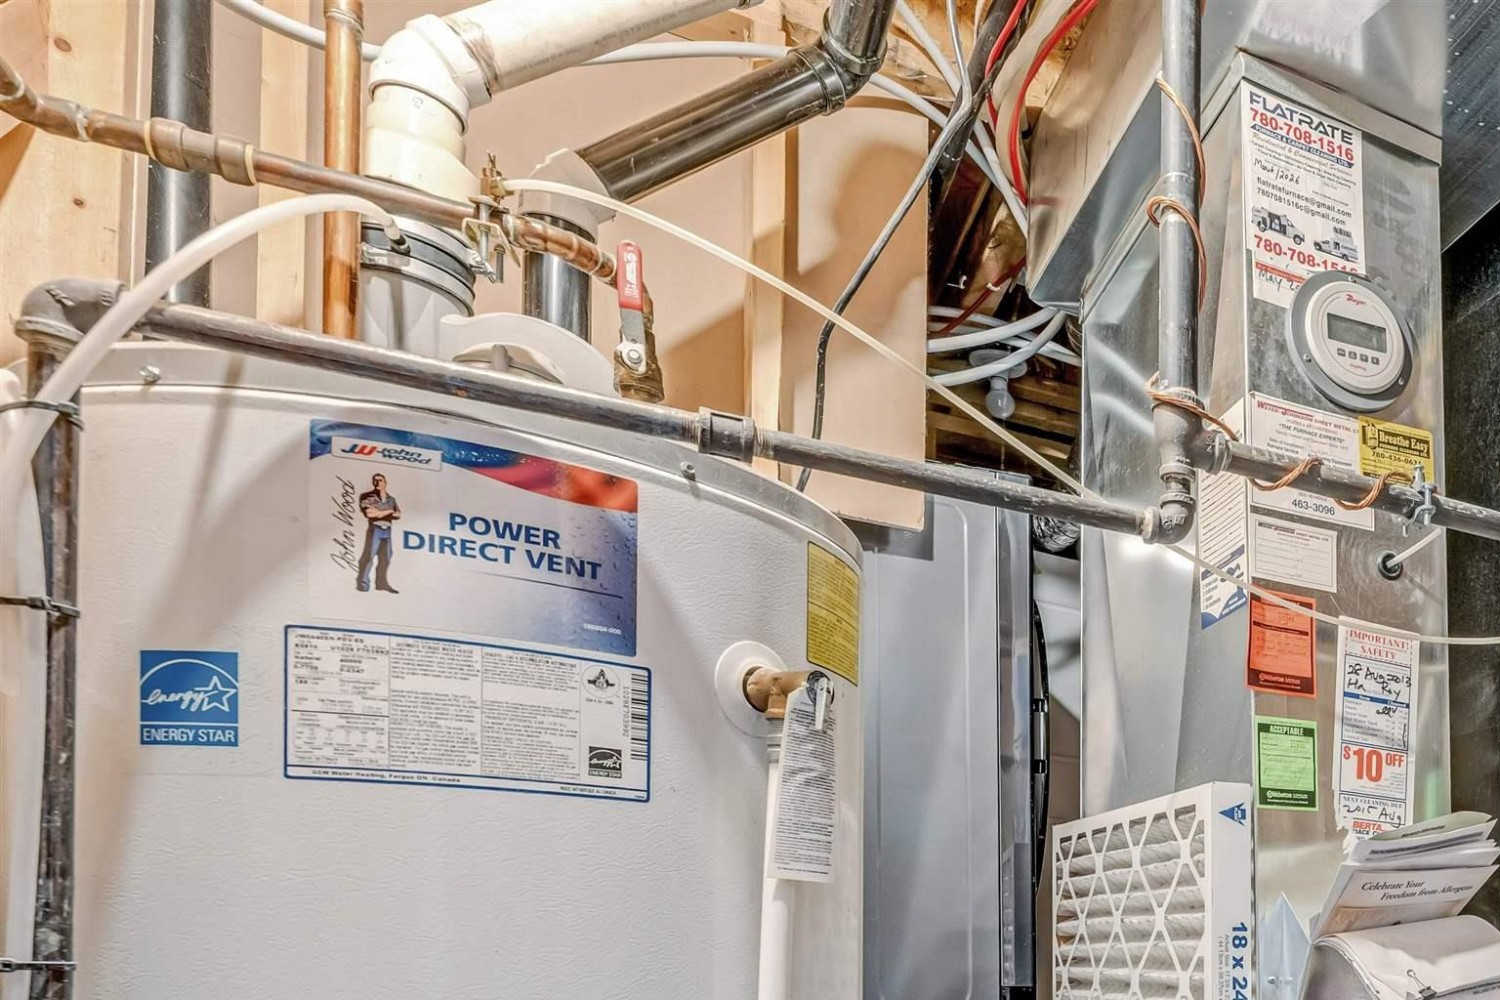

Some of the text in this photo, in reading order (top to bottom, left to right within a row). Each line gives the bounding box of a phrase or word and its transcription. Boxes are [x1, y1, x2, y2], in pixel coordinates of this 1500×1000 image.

[1250, 90, 1353, 145] FLATRATE
[1250, 107, 1354, 161] 780-708-1516
[1310, 147, 1337, 163] CLEANING
[1257, 177, 1352, 218] flatratefurnace@gmail.com
[1294, 427, 1317, 437] FURNACE
[1379, 431, 1428, 452] Breathe Easy
[1292, 499, 1335, 516] 463-3096
[449, 512, 561, 550] POWER
[402, 529, 602, 580] DIRECT VENT
[1349, 629, 1409, 650] IMPORTANT!
[1361, 645, 1397, 659] SAFETY
[143, 728, 235, 742] ENERGY STAR
[1269, 725, 1304, 736] ACCEPTABLE
[1343, 745, 1383, 782] $10
[1385, 753, 1405, 768] OFF
[1378, 807, 1401, 828] Aug
[1361, 880, 1426, 892] Celebrate Your
[1381, 885, 1473, 901] Freedom from Allergens
[1232, 922, 1248, 949] 18
[1232, 956, 1244, 970] x
